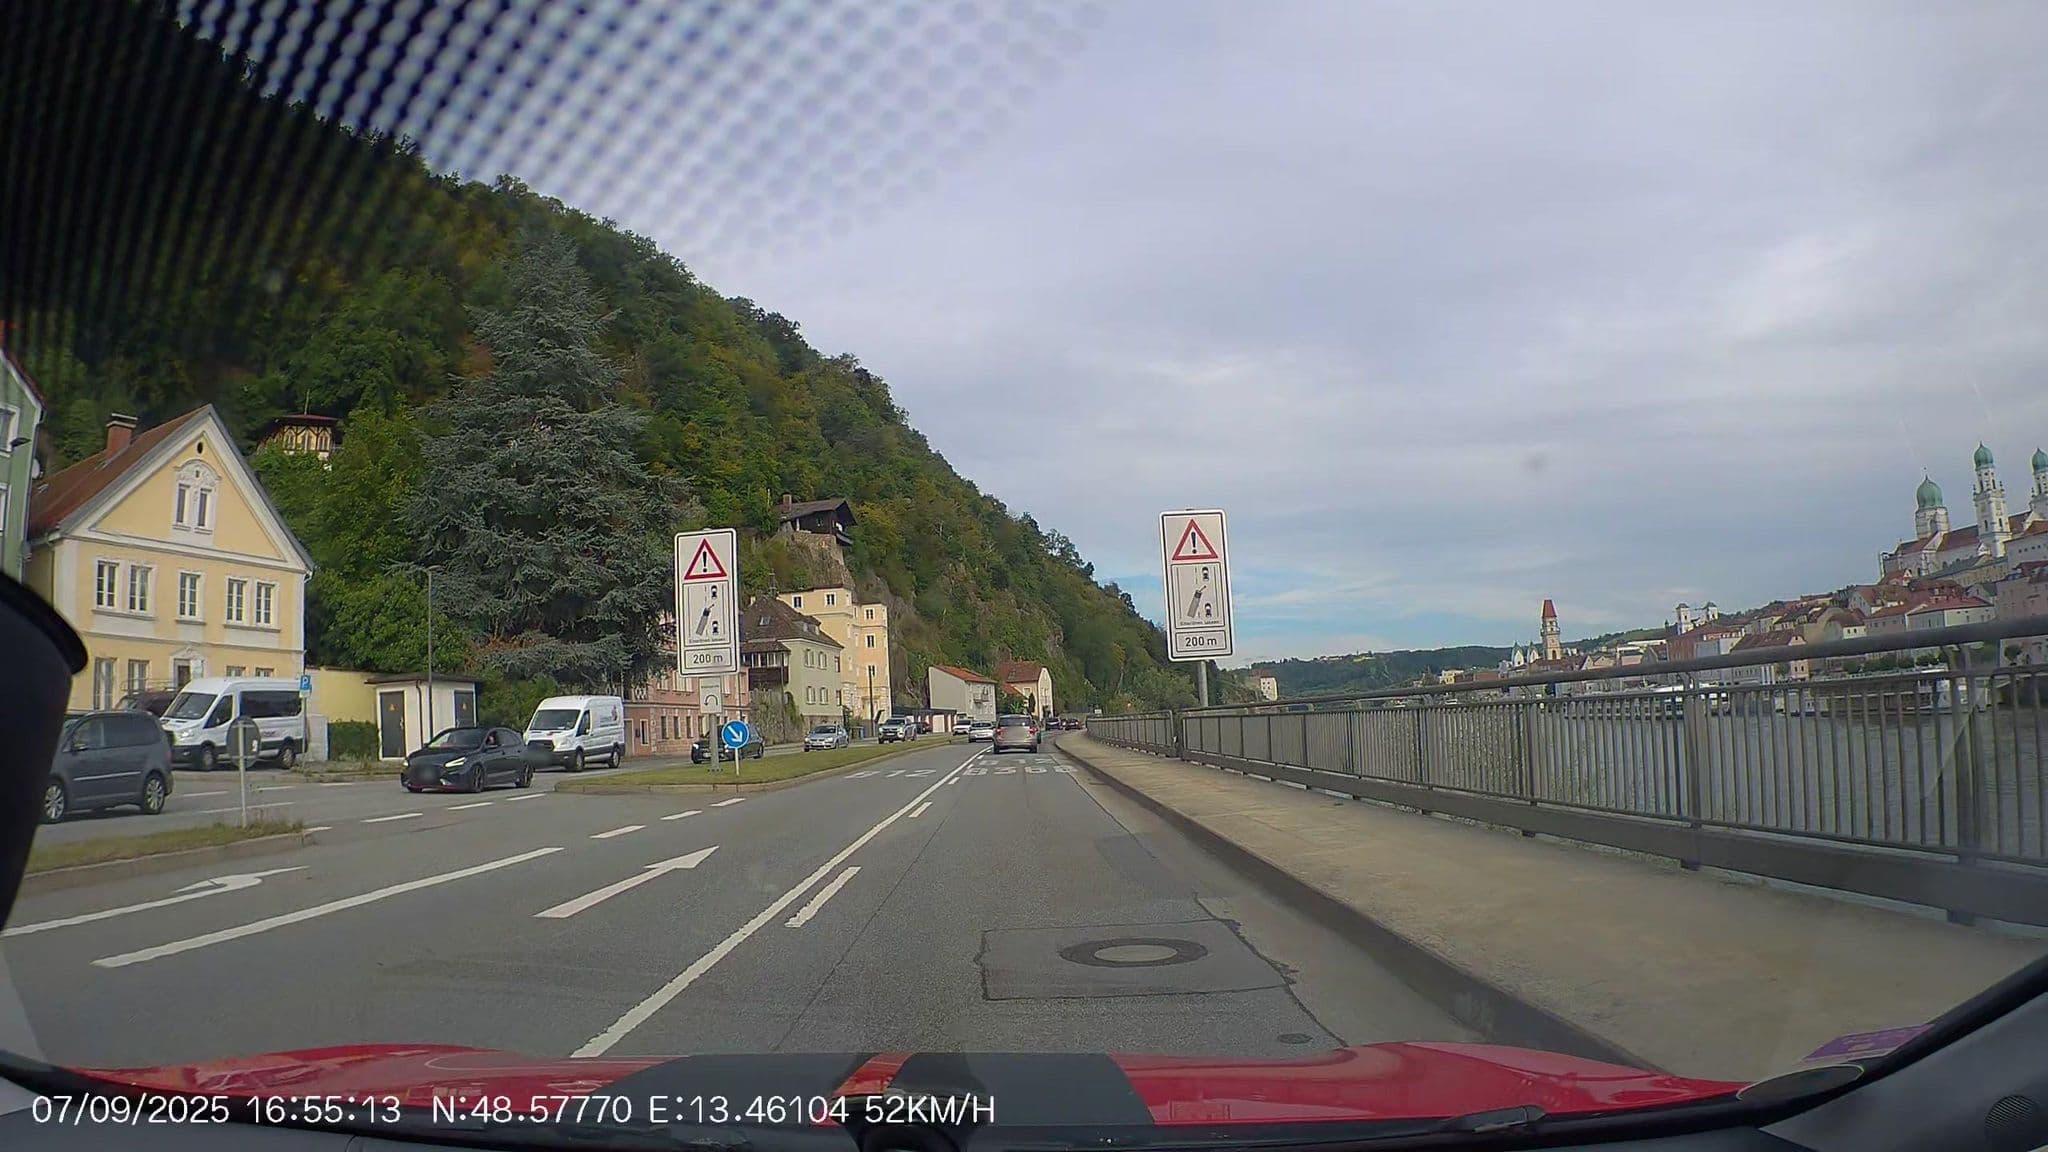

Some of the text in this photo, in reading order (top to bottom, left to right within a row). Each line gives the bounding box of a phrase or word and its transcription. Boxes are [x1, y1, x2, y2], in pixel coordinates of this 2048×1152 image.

[1185, 636, 1217, 647] 200 m
[693, 654, 723, 664] 200 m
[302, 677, 309, 688] P
